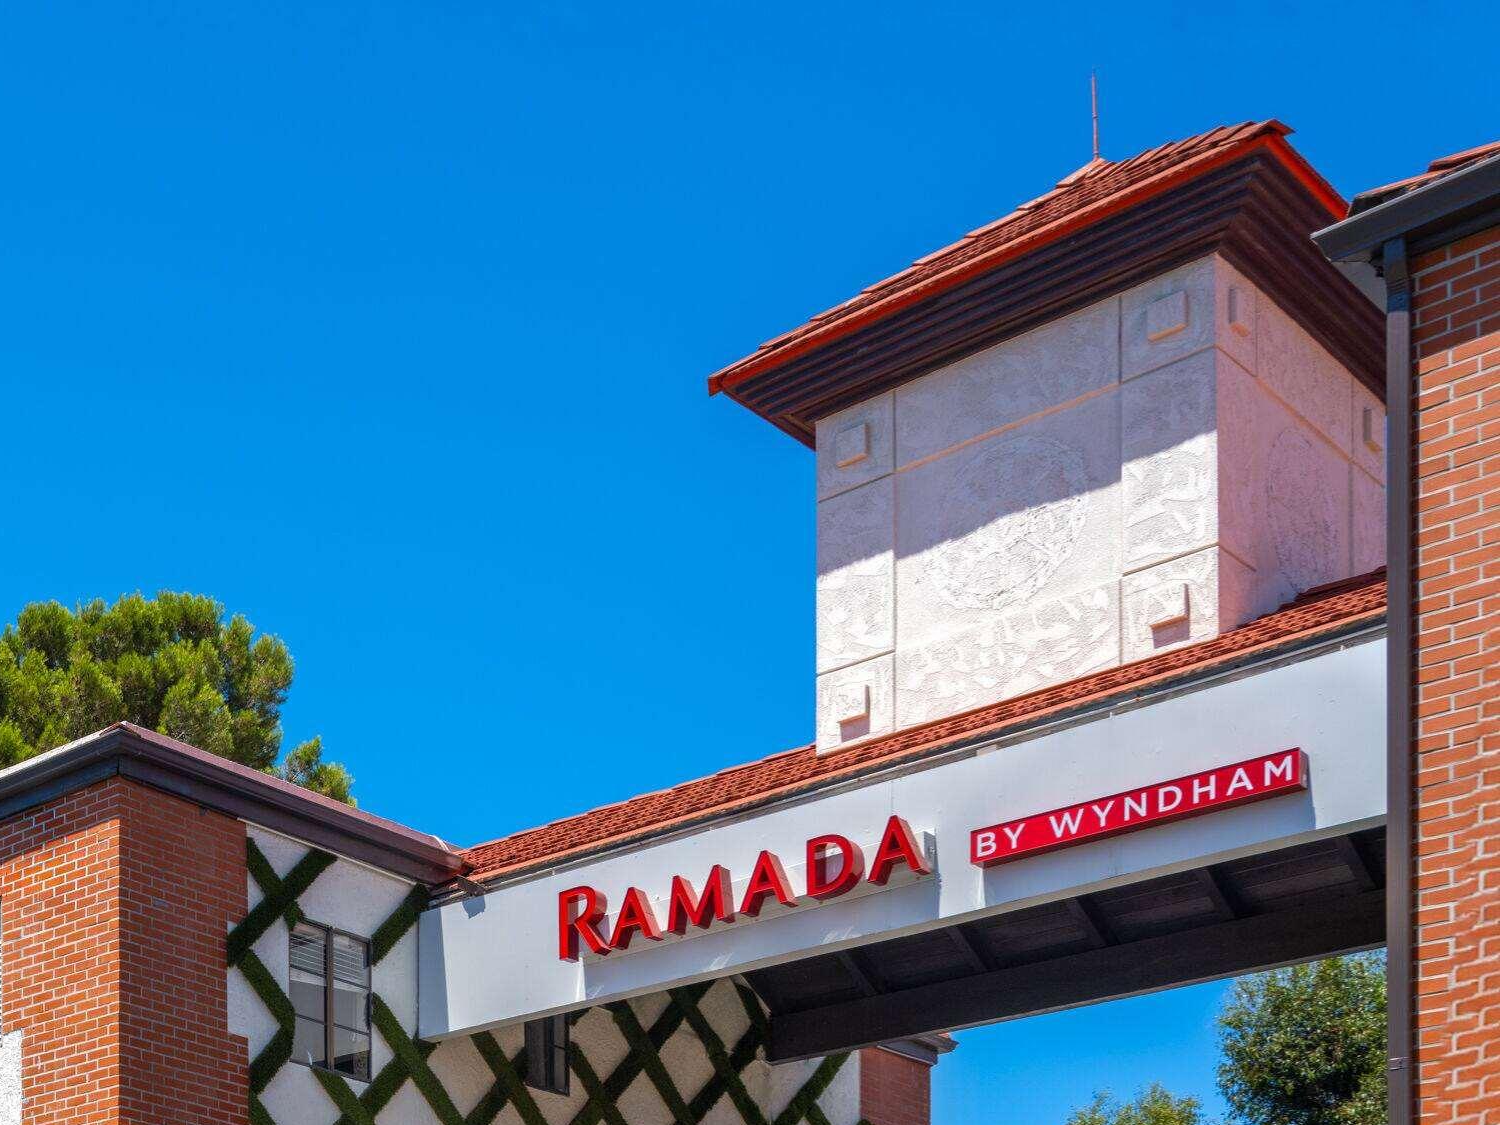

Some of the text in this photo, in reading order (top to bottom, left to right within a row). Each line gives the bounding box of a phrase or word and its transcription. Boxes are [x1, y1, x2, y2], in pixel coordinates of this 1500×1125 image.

[976, 754, 1293, 858] BY WYNDHAM
[558, 815, 931, 963] RAMADA
